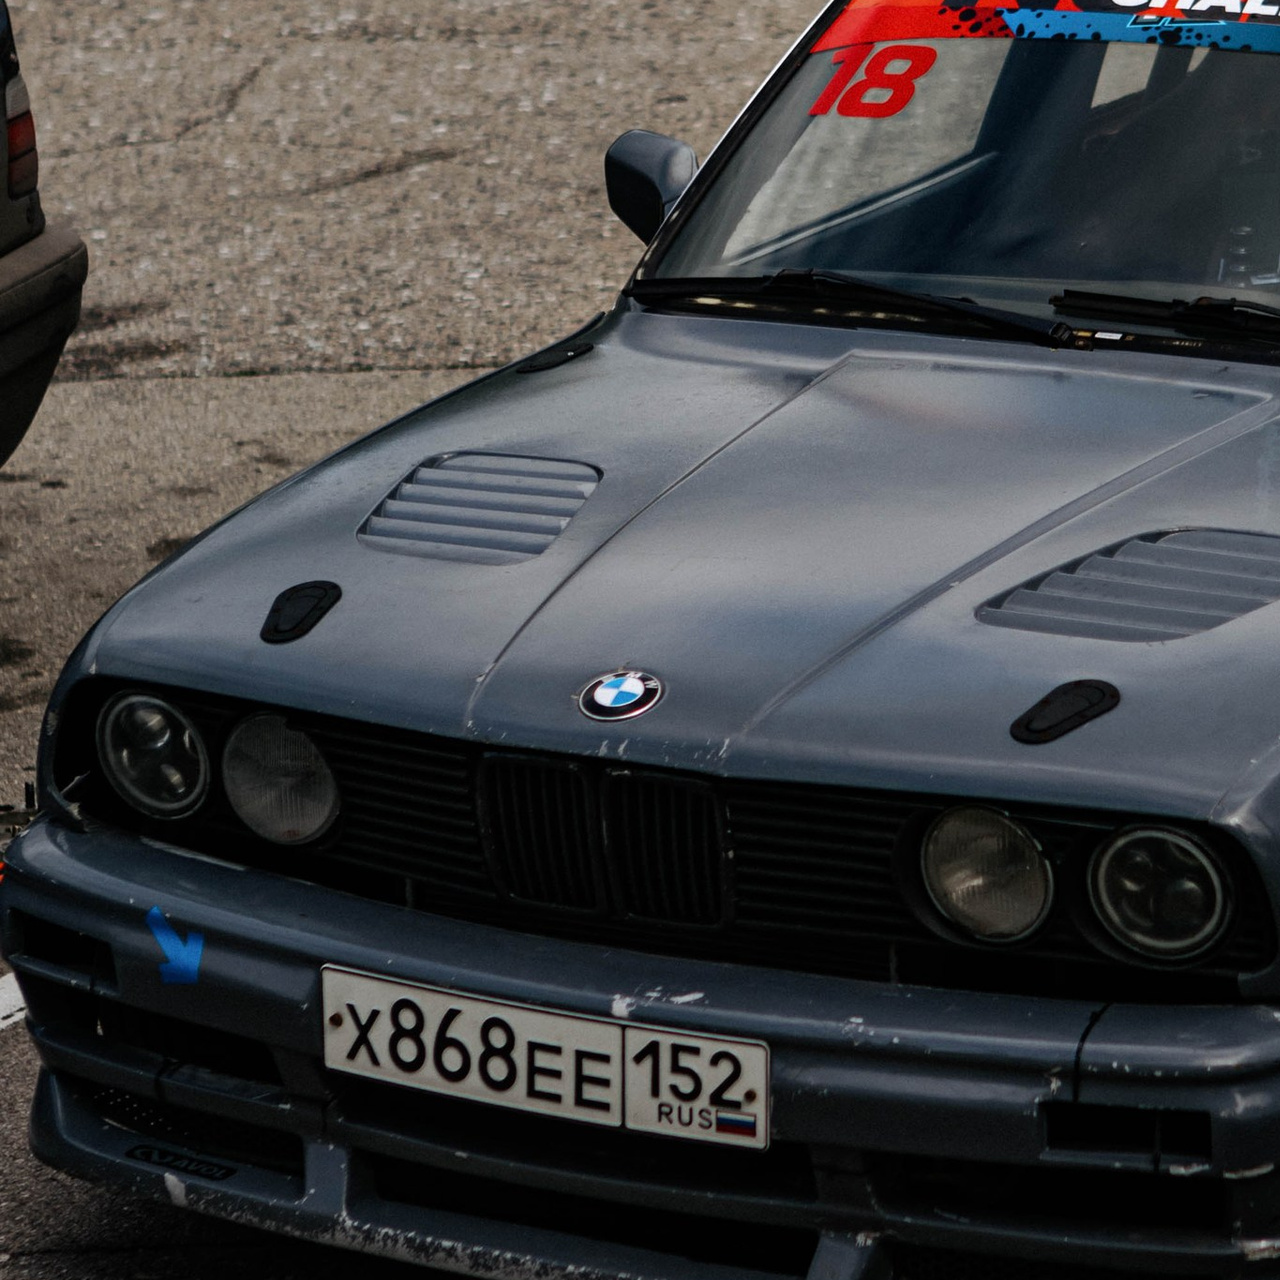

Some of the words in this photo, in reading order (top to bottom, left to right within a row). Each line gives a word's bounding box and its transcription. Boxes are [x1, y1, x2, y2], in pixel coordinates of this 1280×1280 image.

[809, 42, 938, 118] 18
[632, 1039, 743, 1110] 152
[657, 1102, 713, 1130] RUS
